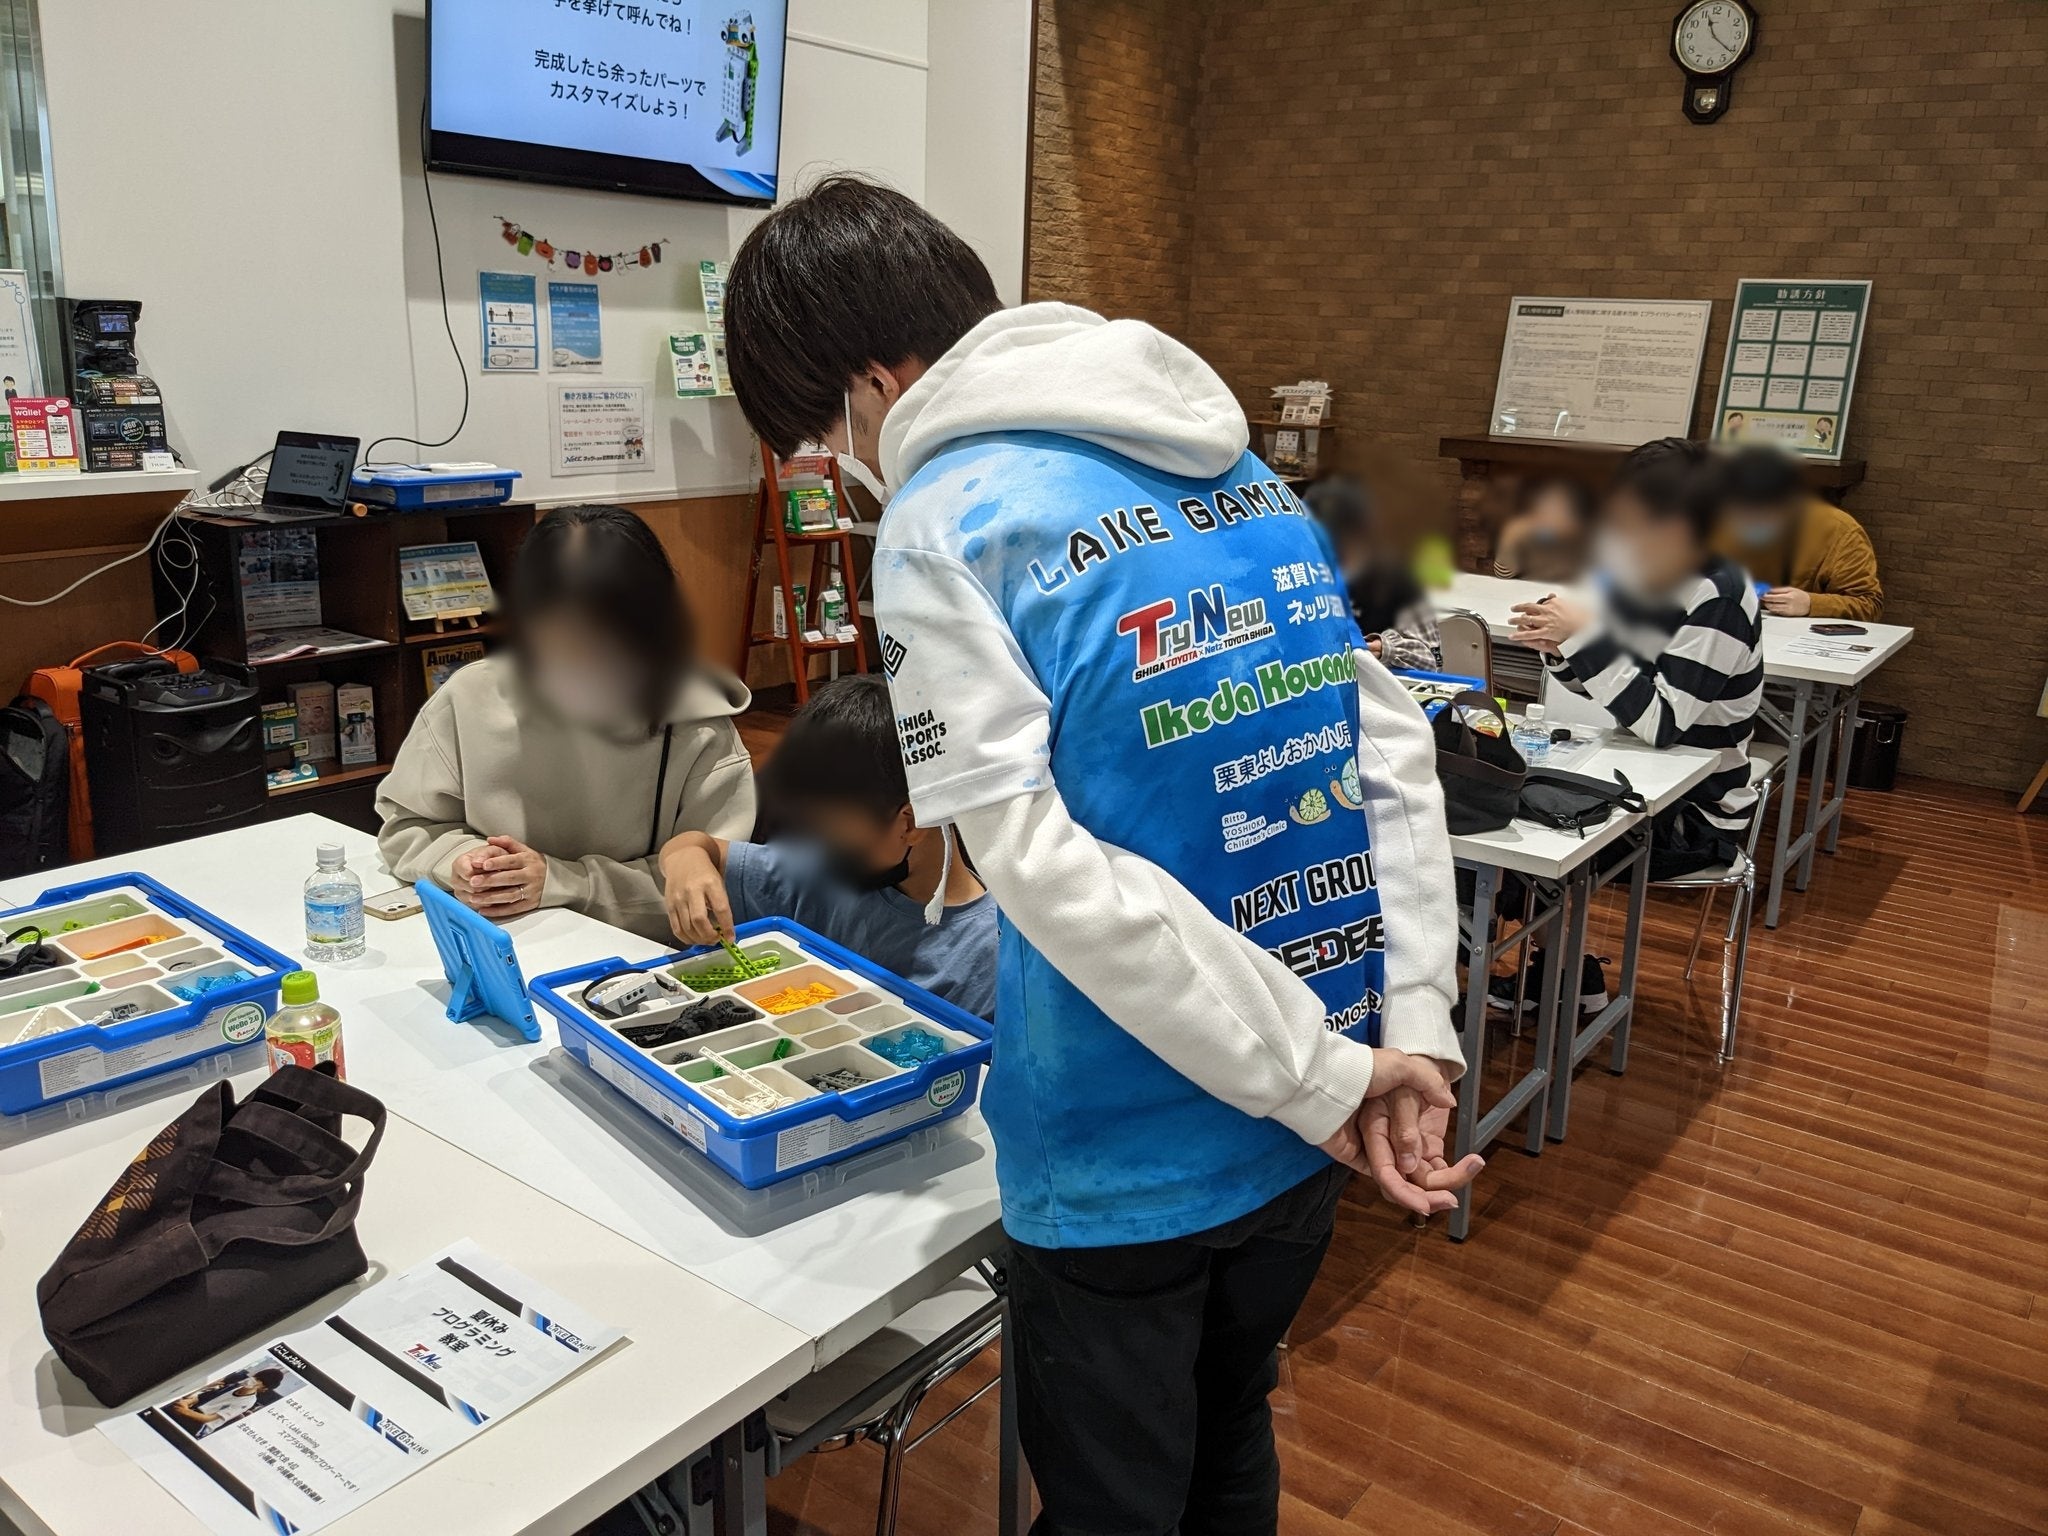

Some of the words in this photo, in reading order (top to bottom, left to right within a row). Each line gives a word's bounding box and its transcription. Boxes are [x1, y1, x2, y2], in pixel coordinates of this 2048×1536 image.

[1702, 10, 1708, 19] 11
[1712, 6, 1722, 14] 12
[1690, 20, 1699, 28] 10
[1733, 19, 1741, 27] 2
[1734, 32, 1741, 40] 3
[1688, 45, 1695, 54] 8
[1719, 54, 1726, 62] 5
[1696, 54, 1703, 63] 7
[1707, 57, 1714, 66] 6
[534, 49, 706, 97] 完成したら余ったパーツで
[550, 81, 689, 120] カスタマイズしよう！
[14, 408, 41, 416] wallet
[1027, 504, 1173, 595] LAKE
[1117, 584, 1266, 667] TryNew
[1140, 678, 1260, 749] Ikeda
[1224, 813, 1245, 824] Ritto
[1225, 818, 1265, 837] YOSHIOKA
[1227, 830, 1266, 850] Children's
[1267, 823, 1286, 837] Clinic
[1232, 872, 1299, 934] NEXT
[1268, 915, 1385, 979] EDEE
[228, 1020, 248, 1032] WeDo
[248, 1014, 259, 1024] 2.0
[951, 1079, 960, 1088] 2.0
[470, 1309, 509, 1334] 夏休み
[432, 1307, 516, 1357] プログラミング
[549, 1324, 568, 1339] LAKE
[438, 1332, 471, 1353] 教室
[273, 1344, 307, 1370] じこしょうかい
[379, 1420, 400, 1436] LAKE
